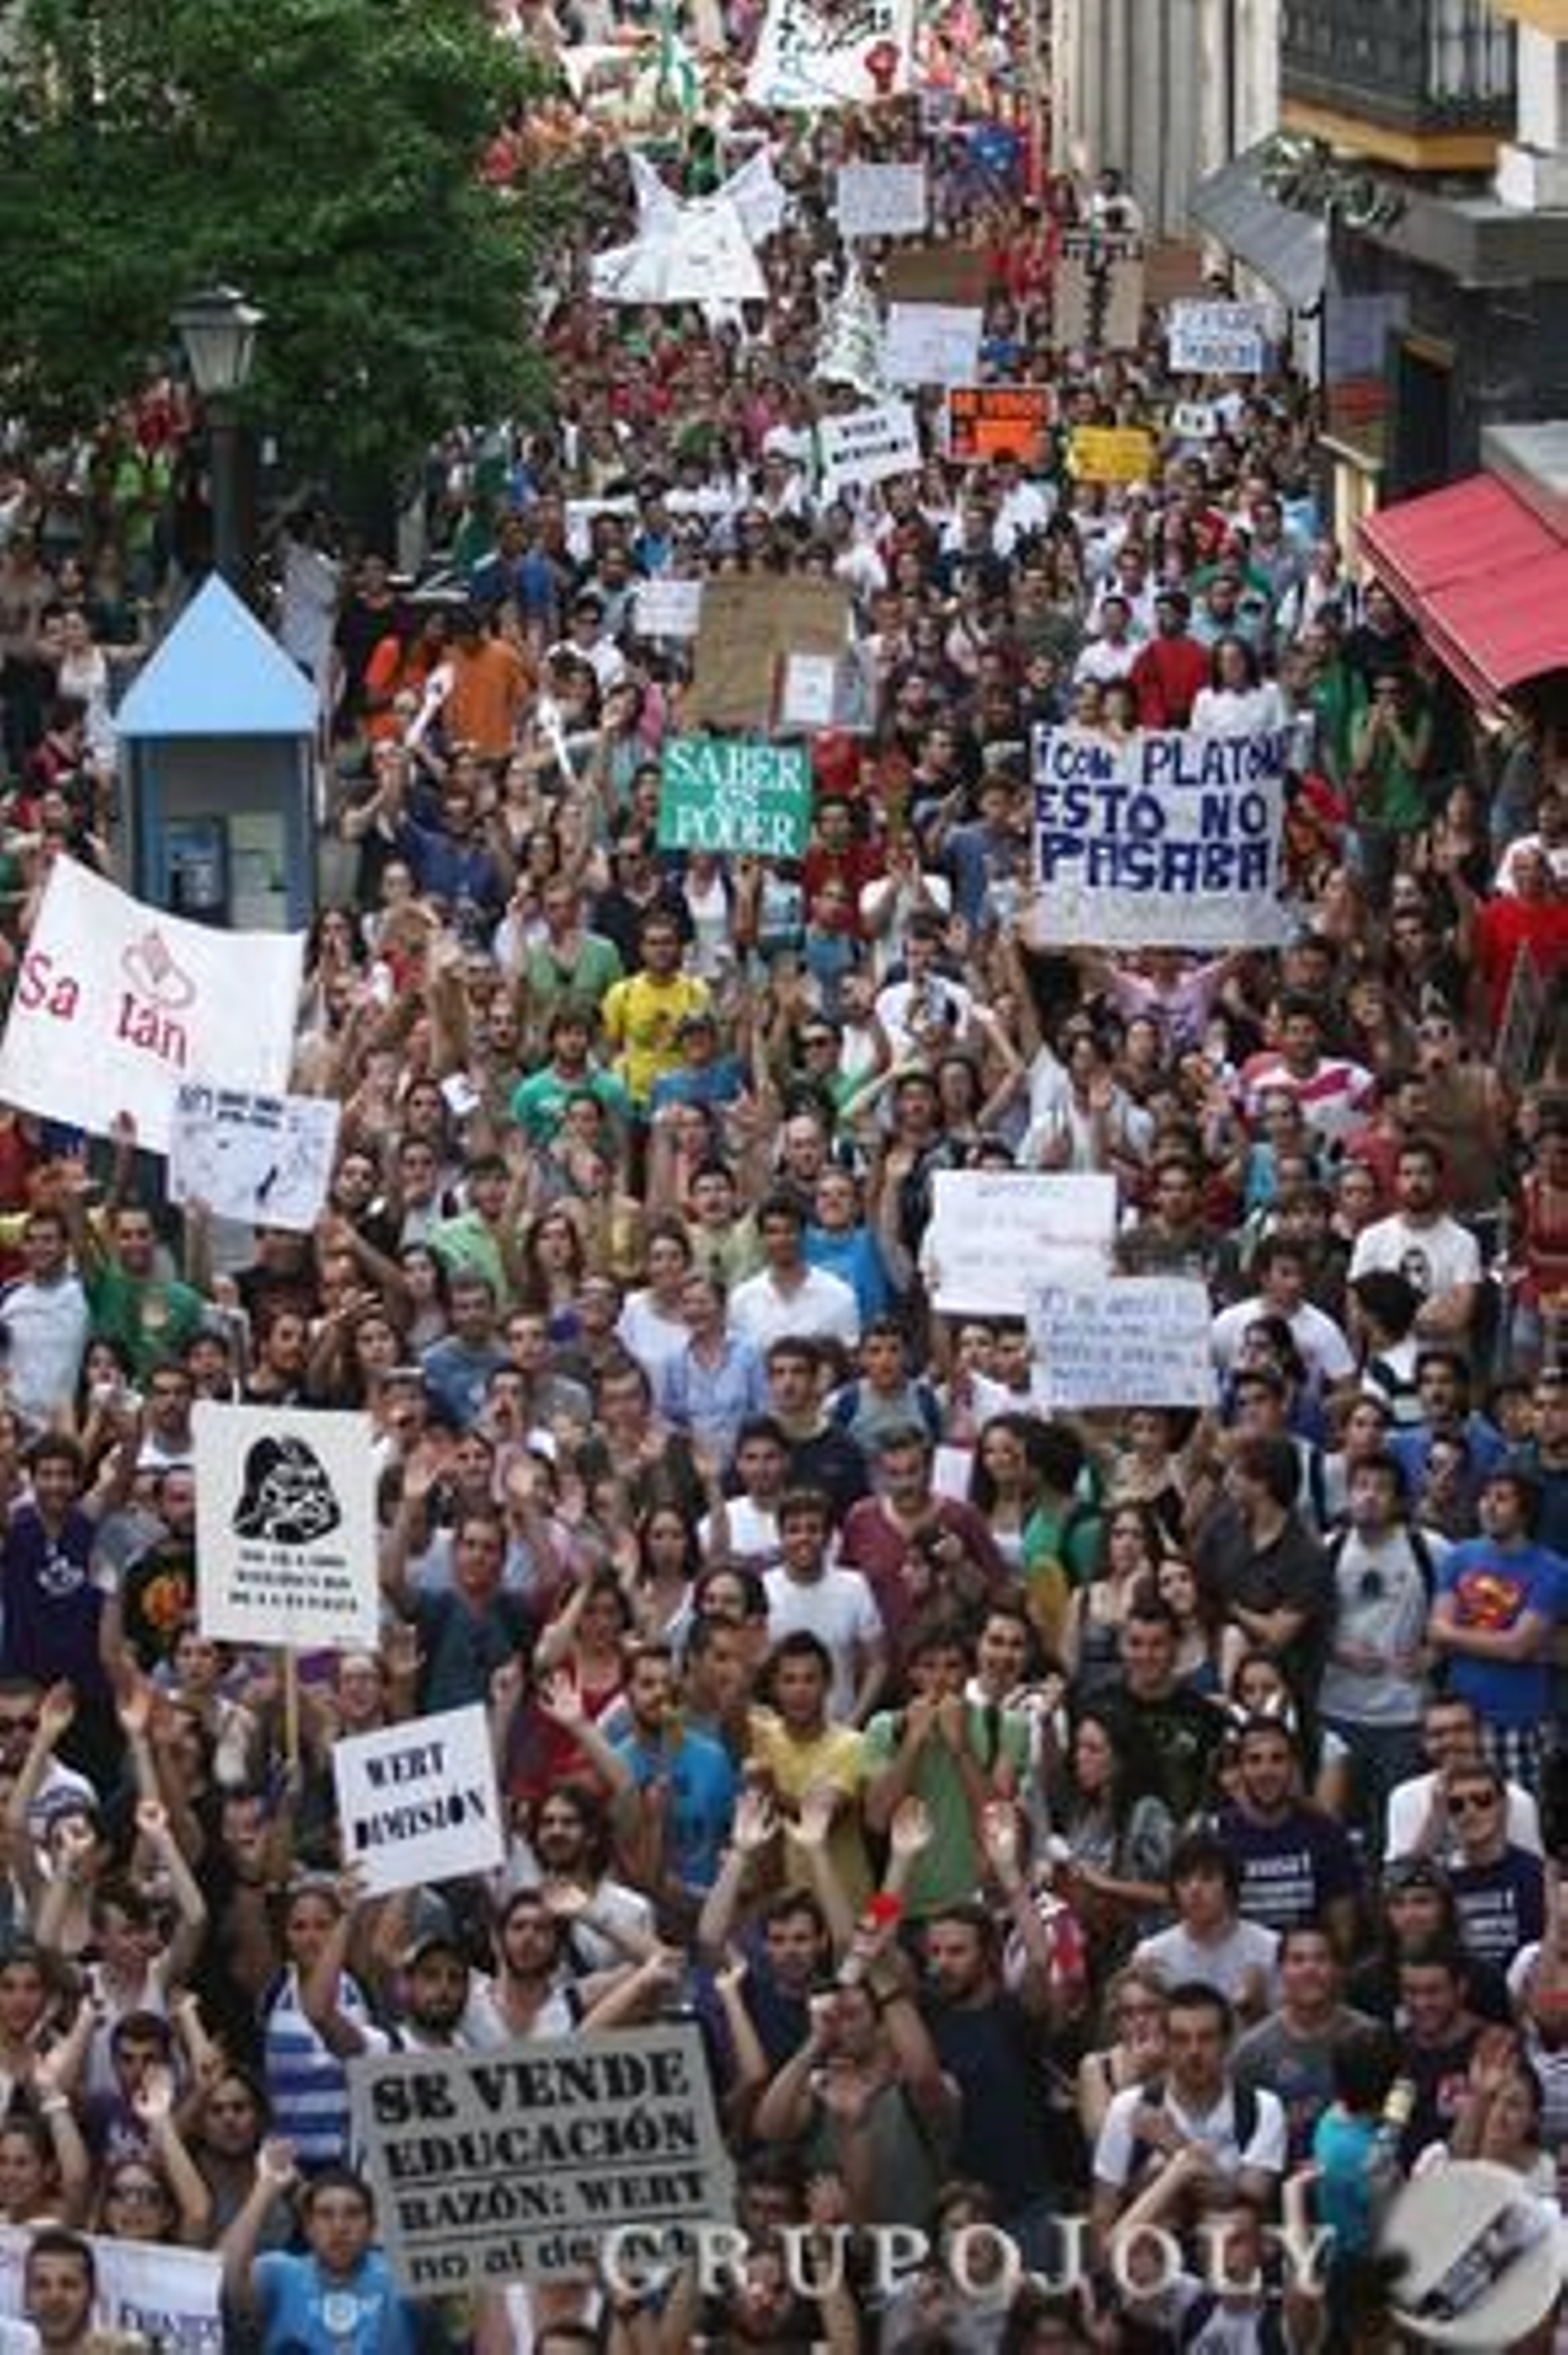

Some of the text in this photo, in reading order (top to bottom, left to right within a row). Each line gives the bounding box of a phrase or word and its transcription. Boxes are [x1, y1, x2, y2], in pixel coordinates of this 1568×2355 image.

[662, 741, 804, 793] SABER
[676, 802, 800, 857] PODER
[1035, 783, 1268, 838] ESTO NO
[1041, 832, 1270, 893] PASABA
[19, 951, 78, 1020] Sa
[367, 1742, 445, 1790] WERT
[371, 2048, 690, 2126] SE VENDE
[384, 2105, 698, 2178] EDUCACIÓN
[397, 2169, 708, 2231] RAZÓN: WERT
